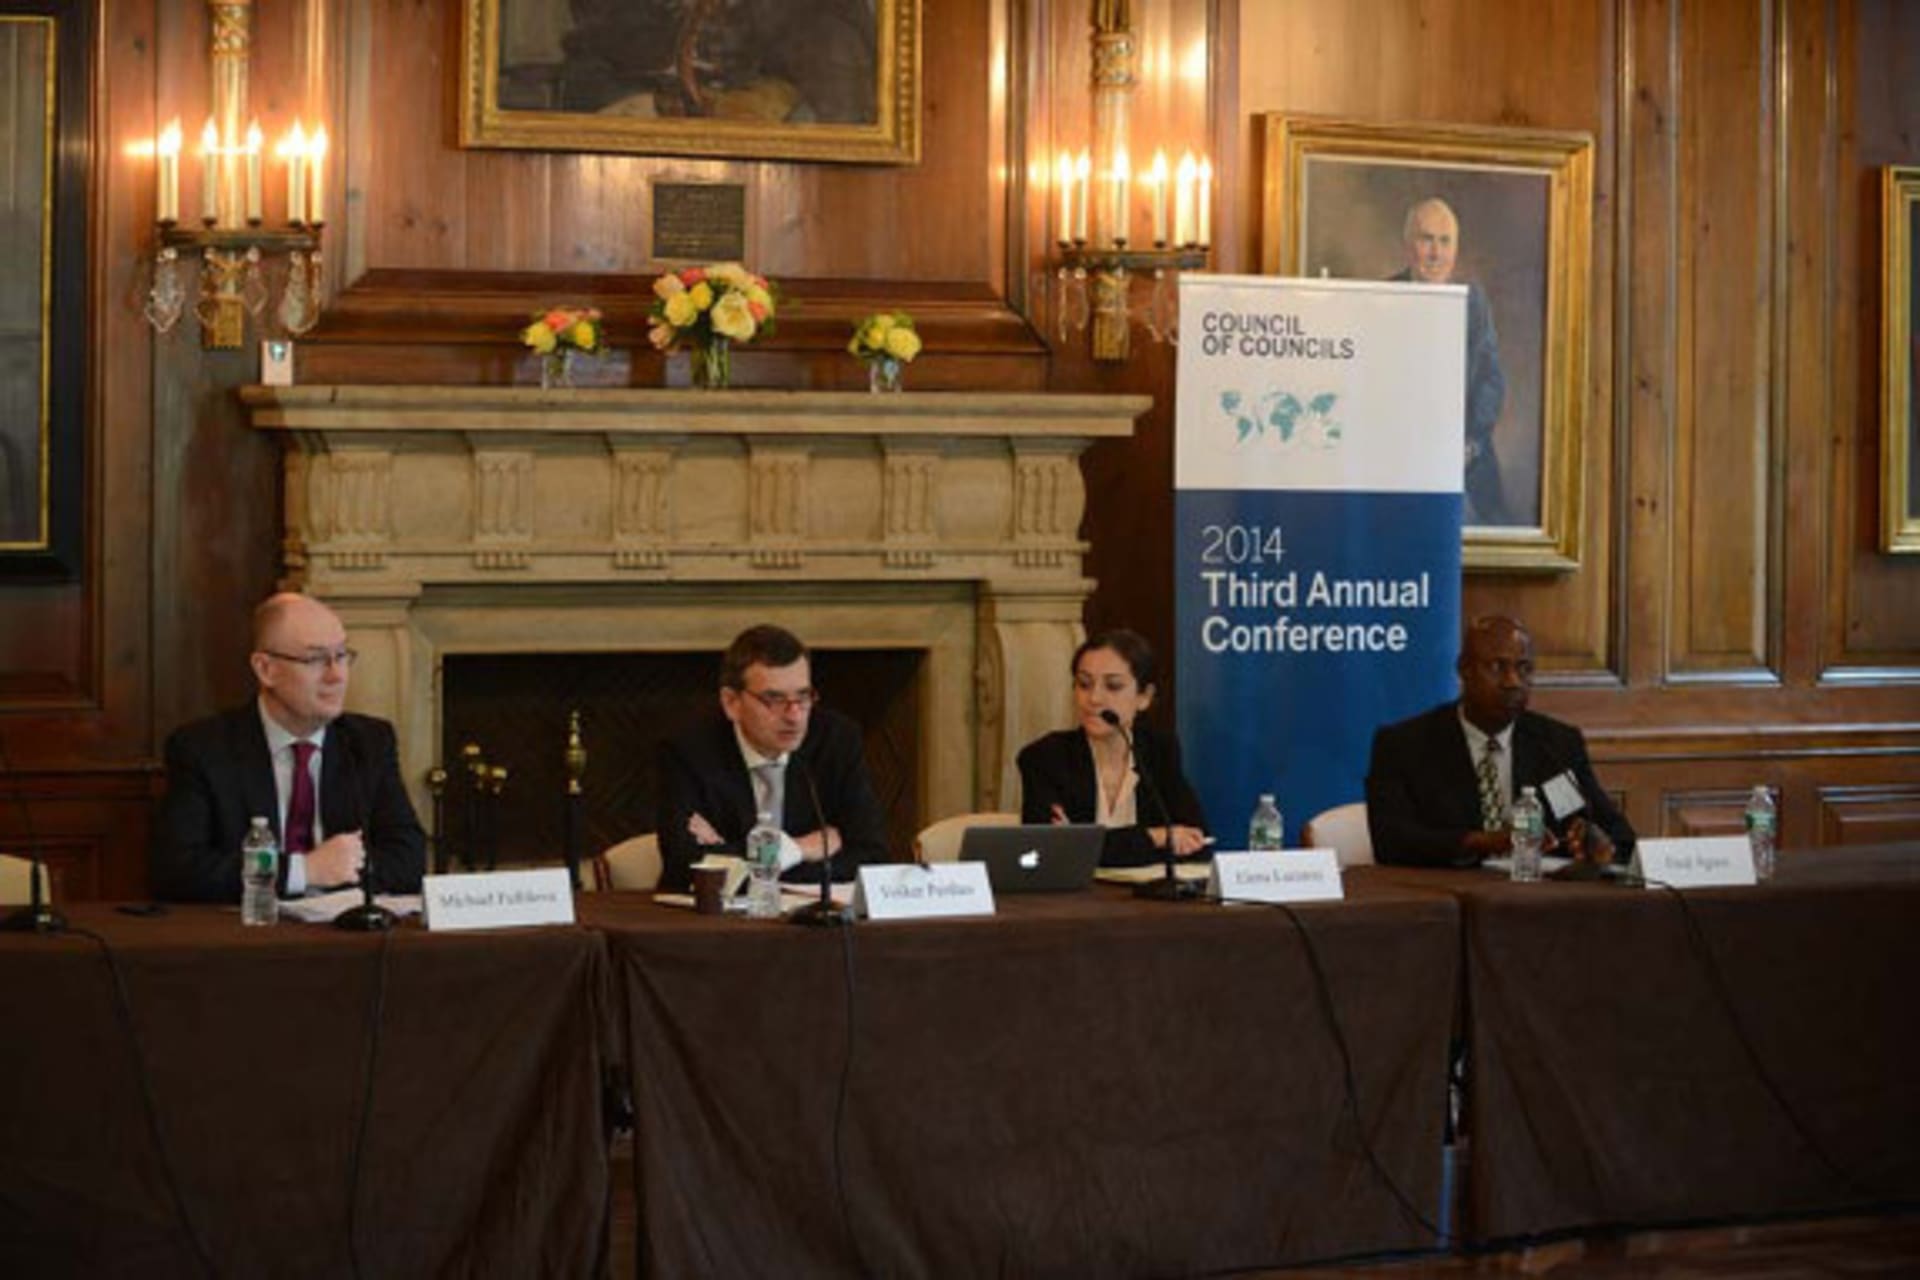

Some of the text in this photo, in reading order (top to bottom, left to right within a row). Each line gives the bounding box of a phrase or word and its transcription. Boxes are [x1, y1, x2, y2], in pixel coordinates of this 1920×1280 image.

[1202, 312, 1305, 336] COUNCIL
[1202, 334, 1355, 360] OF COUNCILS
[1201, 525, 1286, 564] 2014
[1201, 571, 1430, 608] Third Annual
[1202, 616, 1409, 652] Conference
